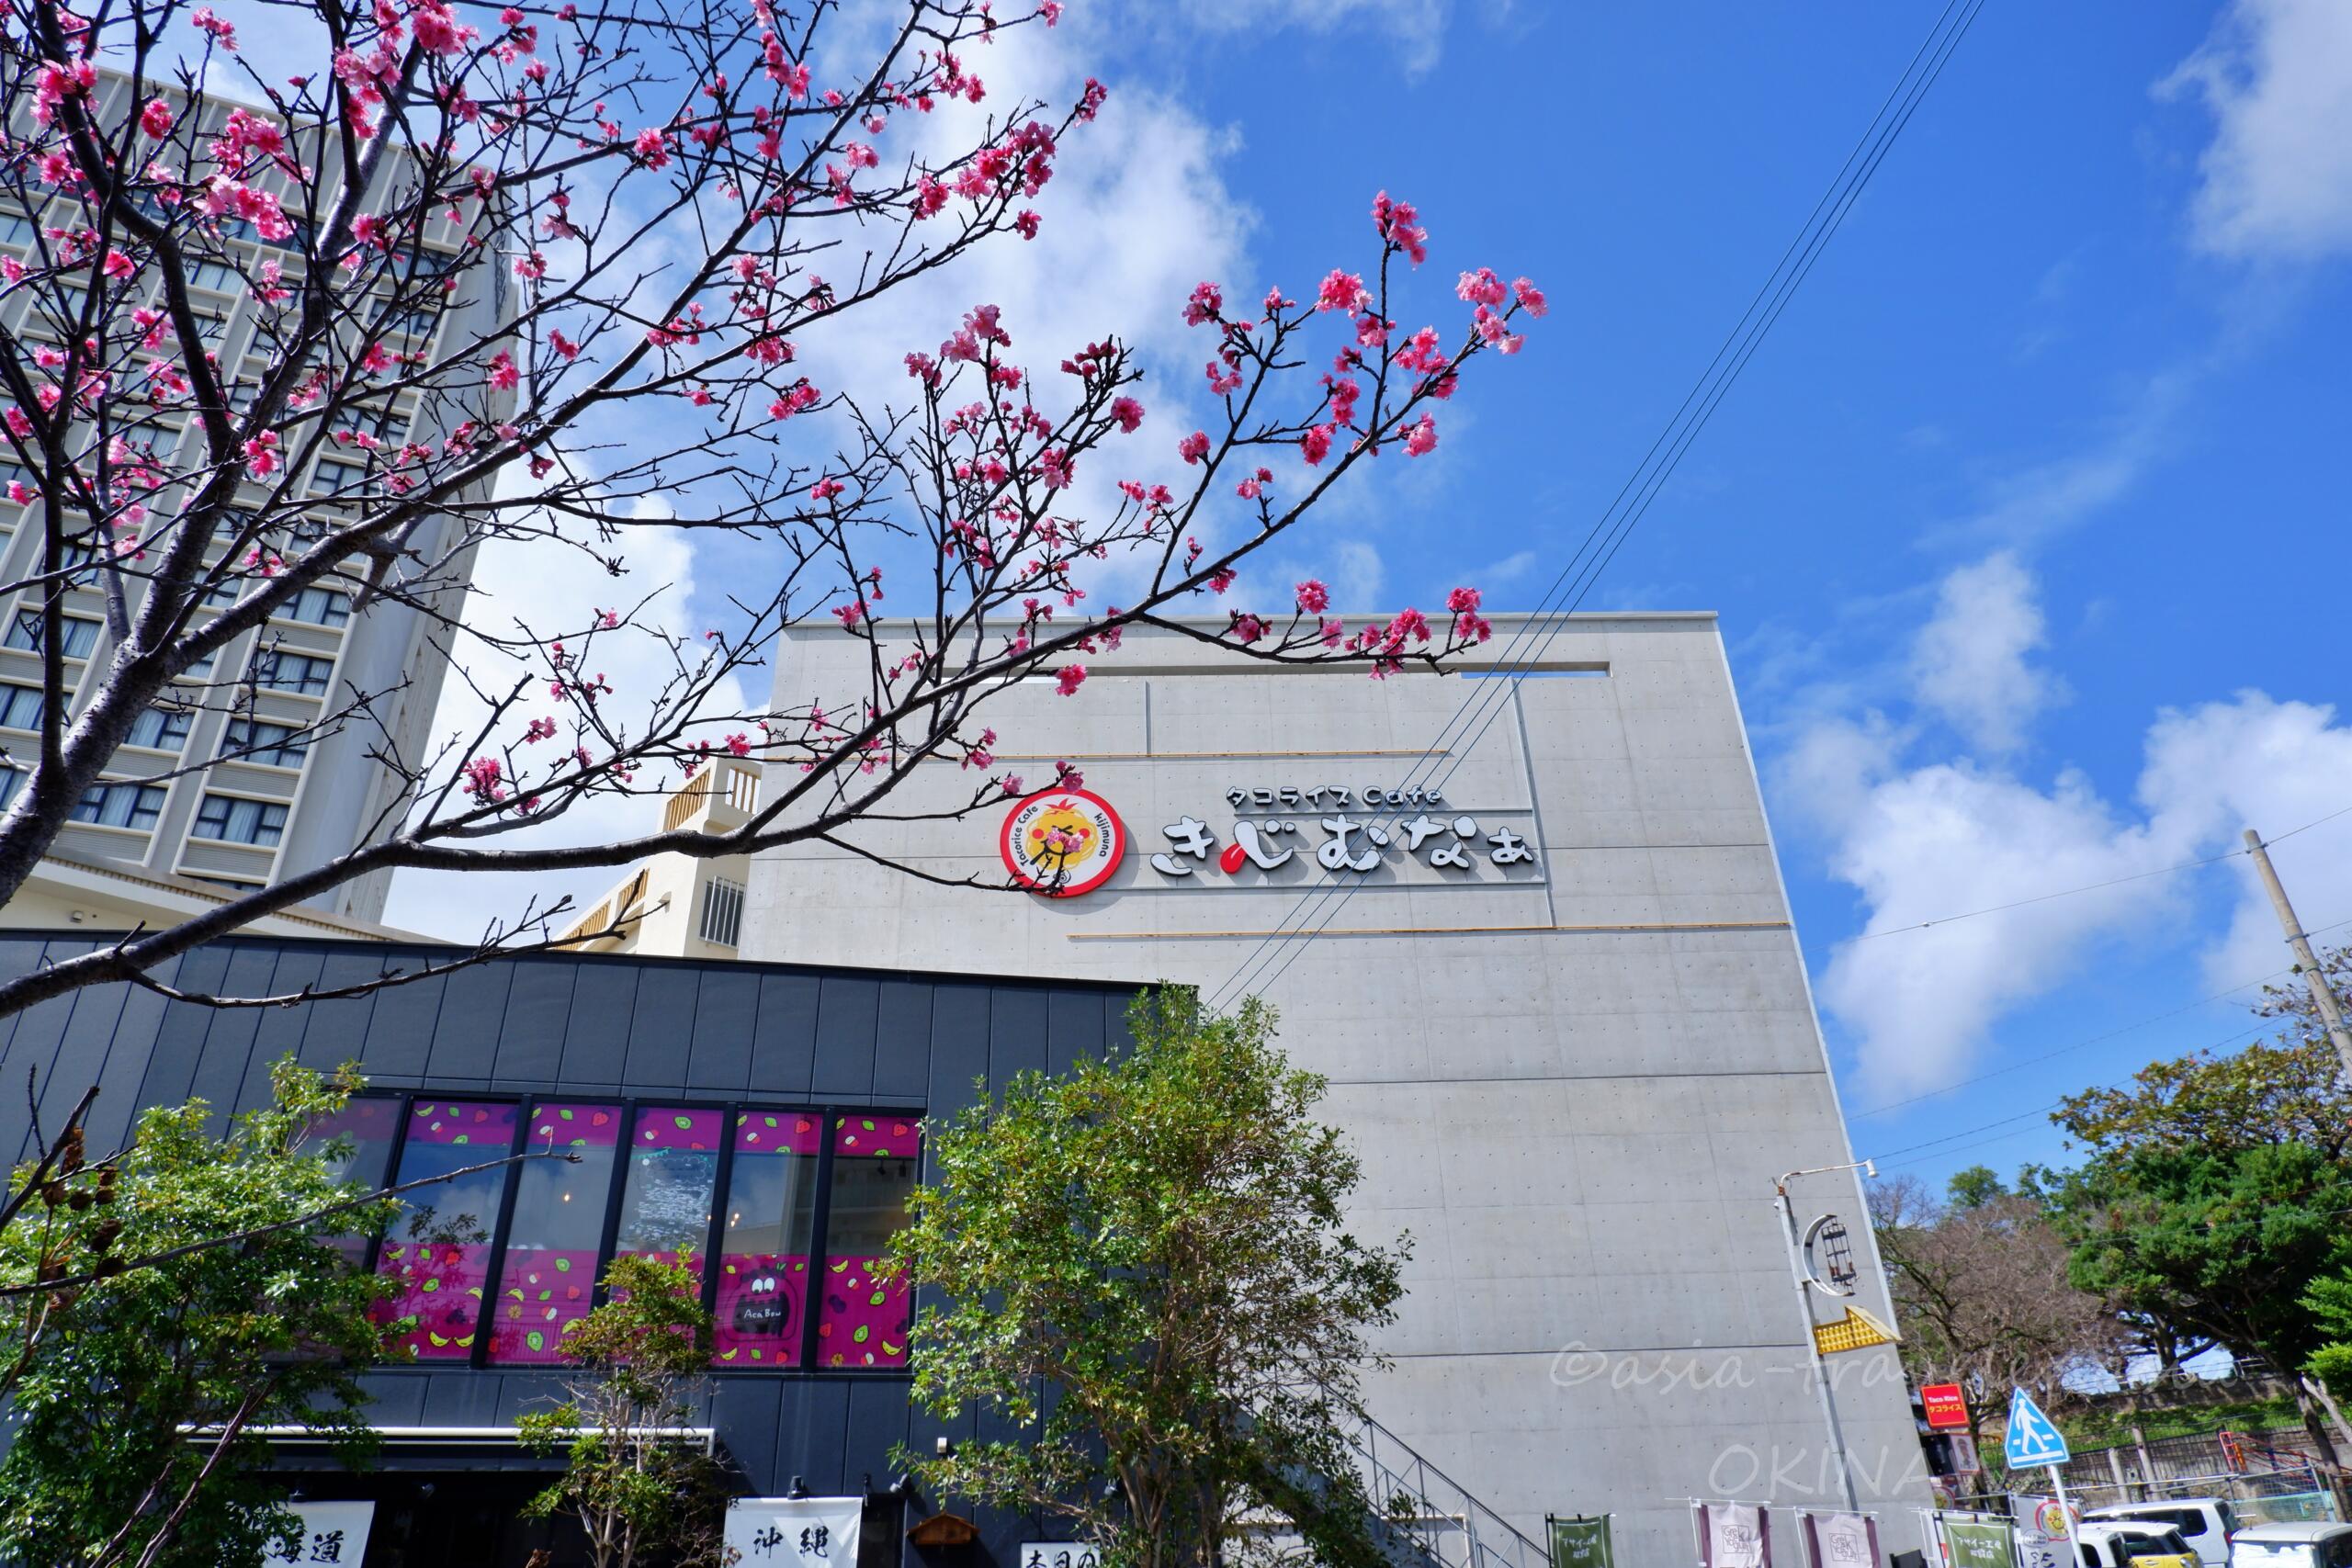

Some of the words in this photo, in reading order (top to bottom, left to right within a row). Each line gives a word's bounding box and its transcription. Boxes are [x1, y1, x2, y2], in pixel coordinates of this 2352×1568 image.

[1226, 785, 1351, 807] タコライス
[1362, 784, 1442, 806] Cafe
[1017, 805, 1039, 825] Cafe
[1012, 827, 1030, 867] Tacorice
[1093, 812, 1110, 858] kijimuna
[752, 1526, 830, 1559] 沖縄
